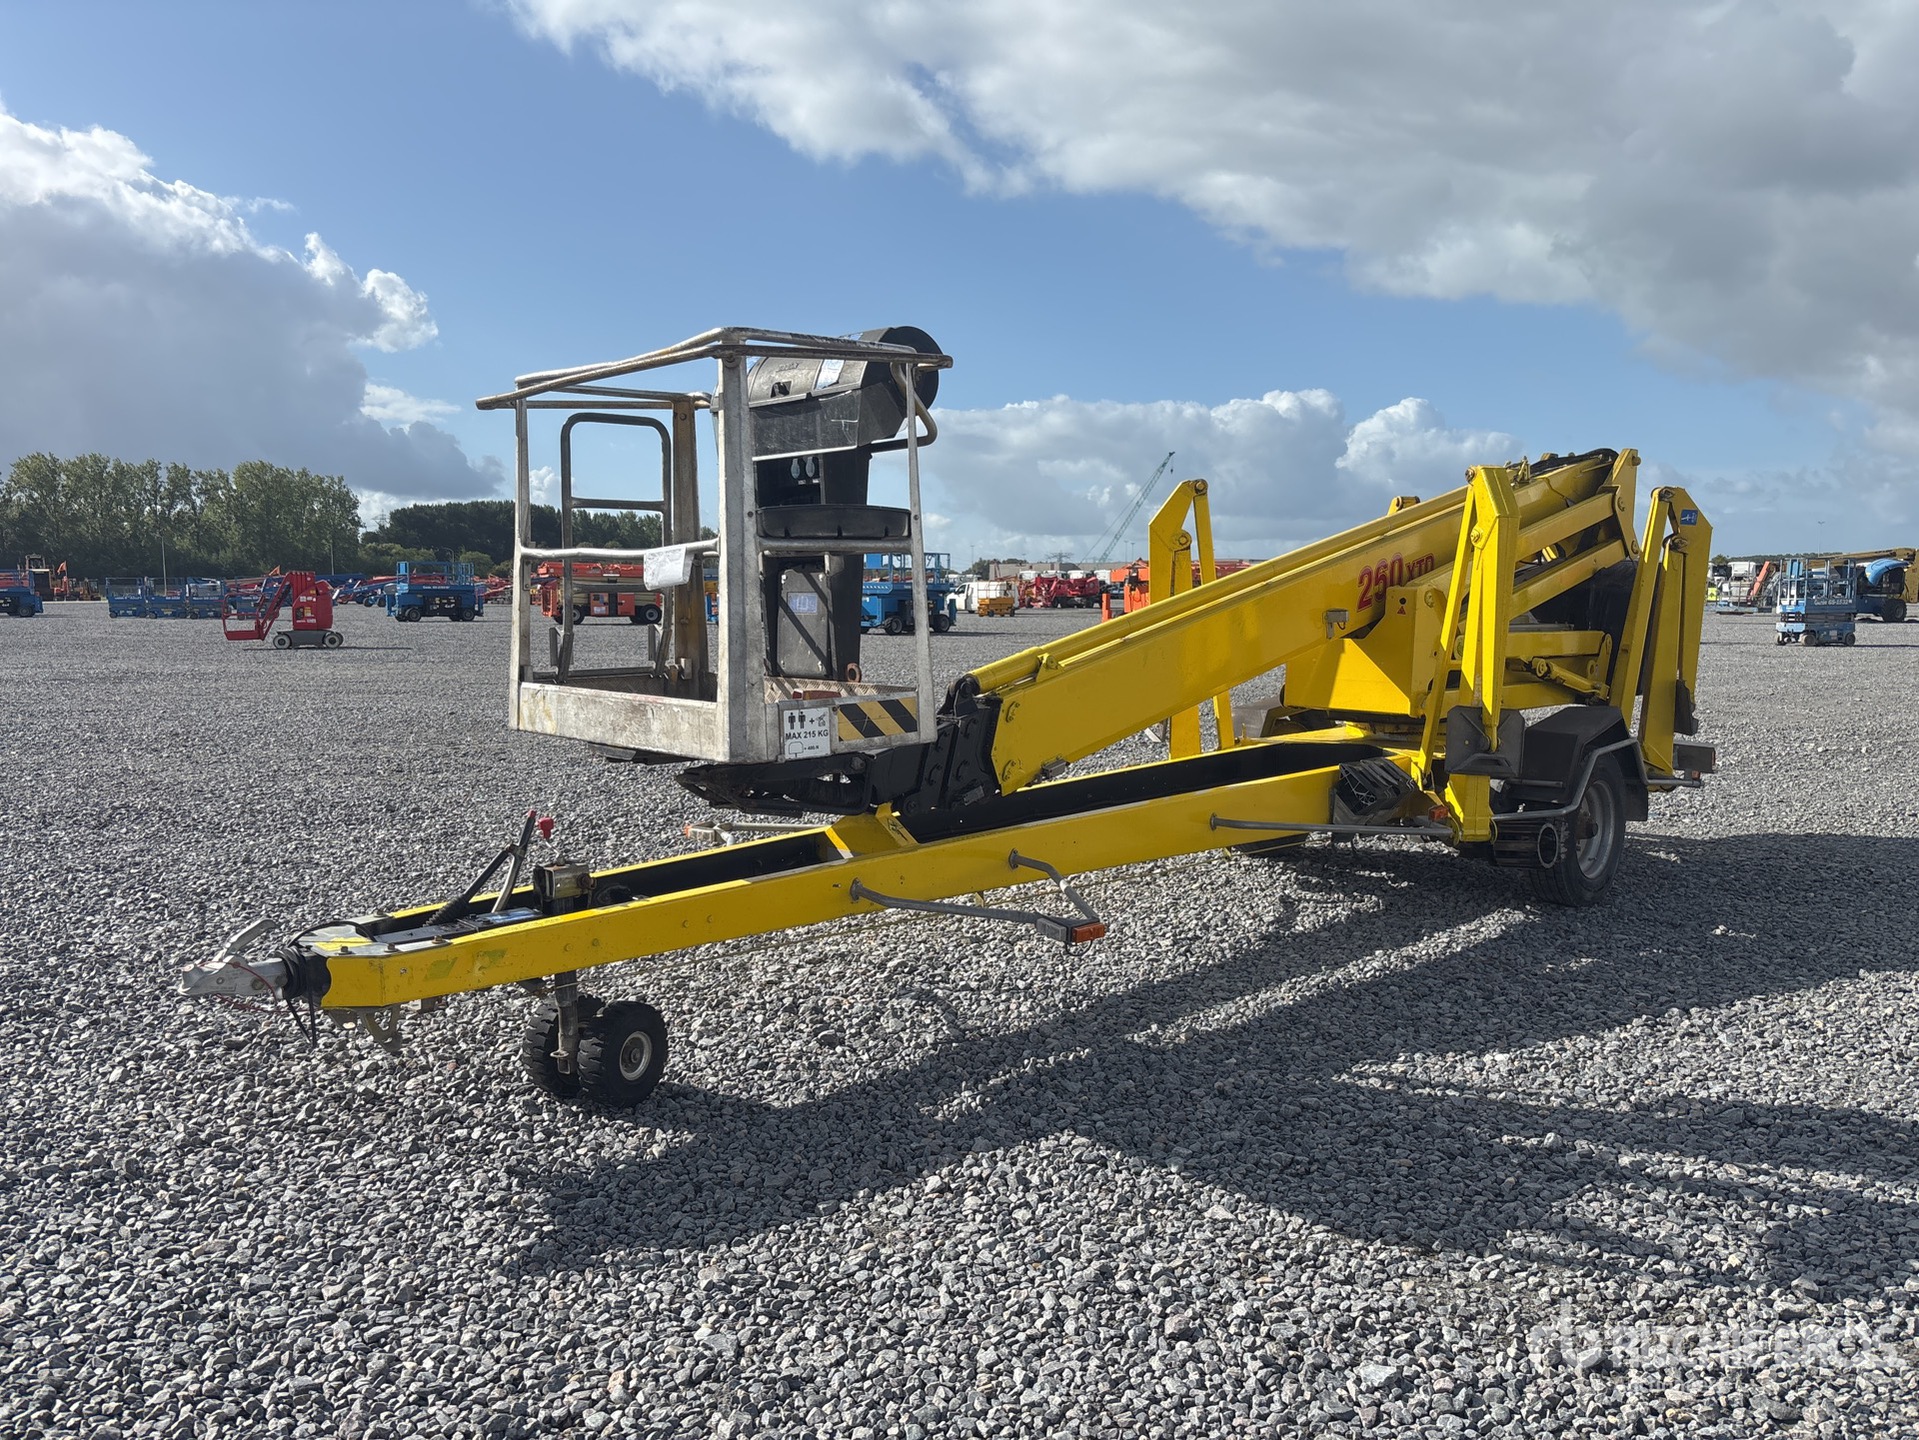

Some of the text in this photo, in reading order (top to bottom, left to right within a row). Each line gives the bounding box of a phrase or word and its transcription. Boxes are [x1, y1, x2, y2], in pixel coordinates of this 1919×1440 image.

[785, 729, 829, 740] MAX 215 KG
